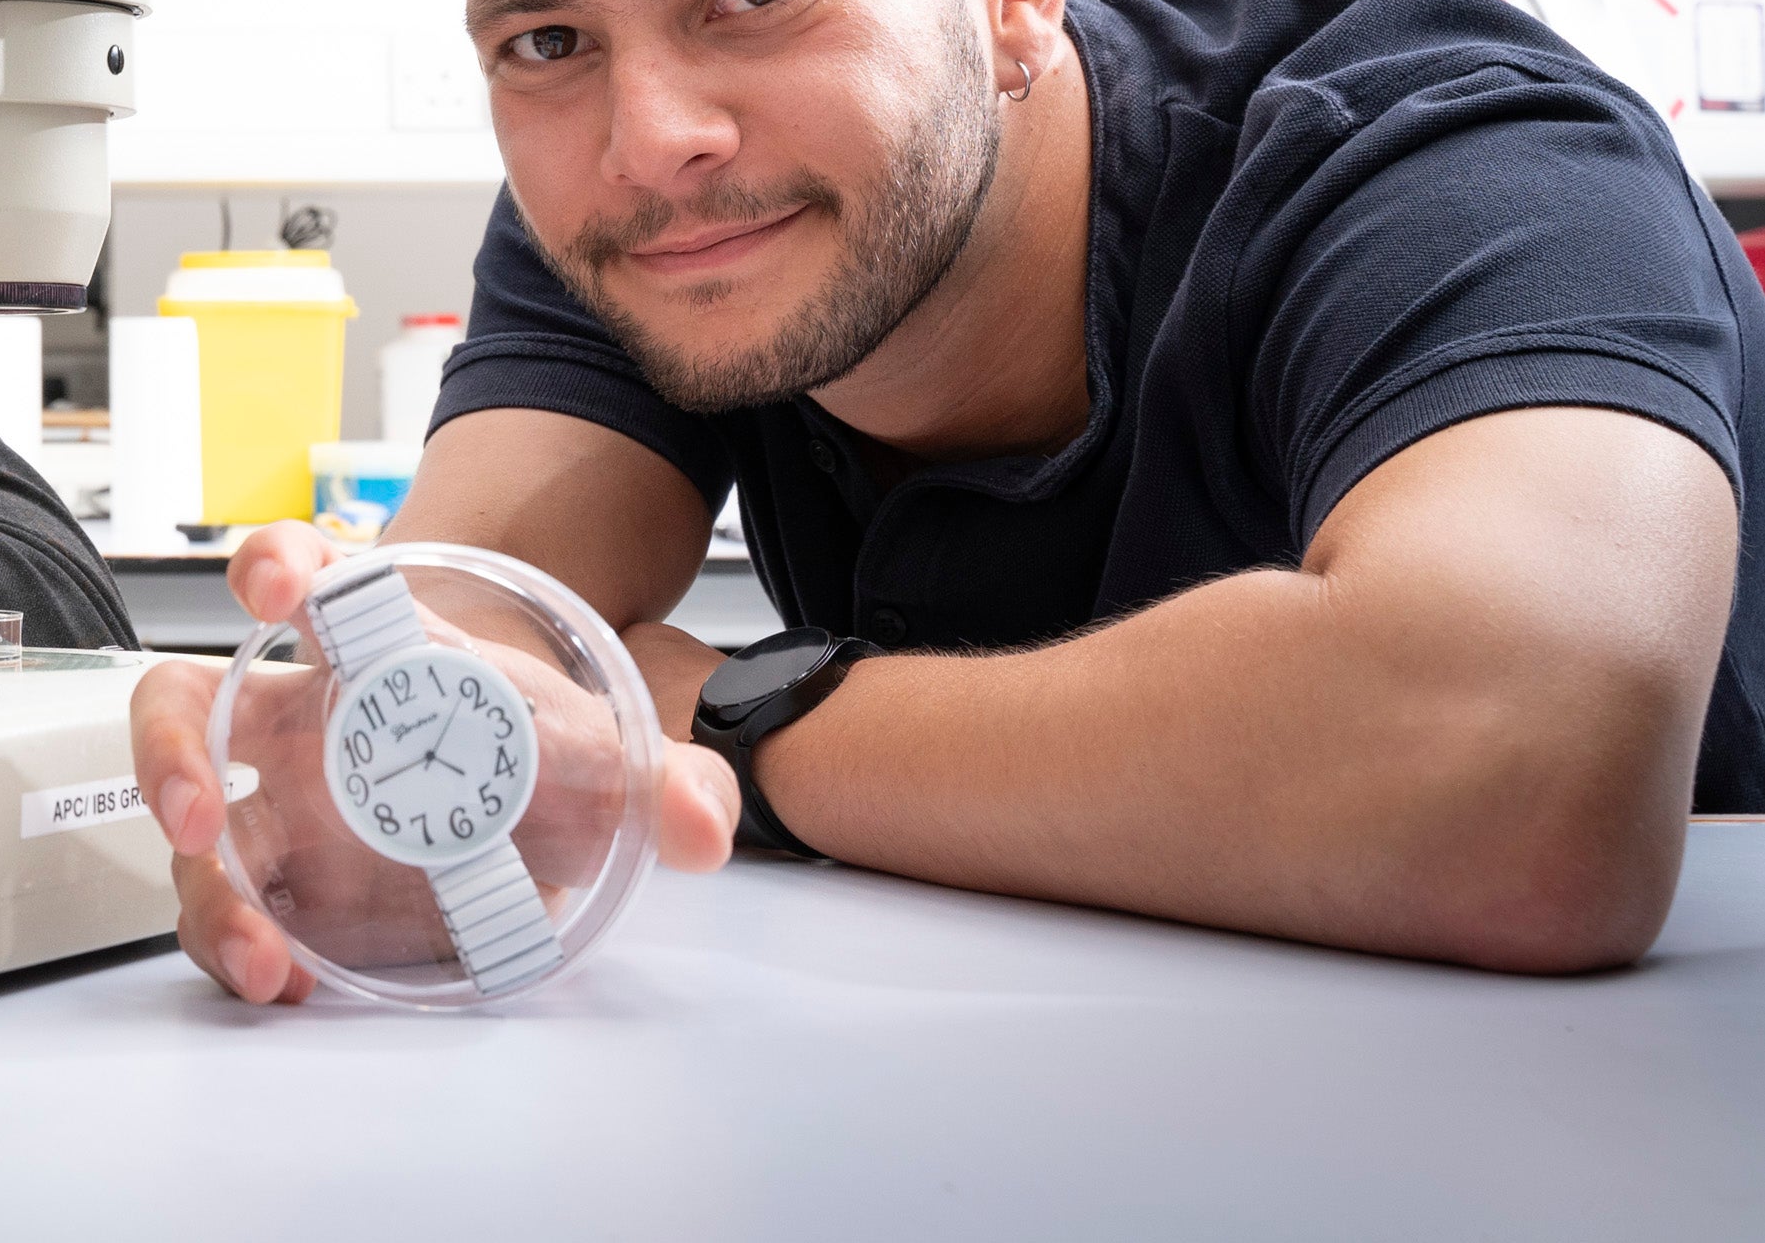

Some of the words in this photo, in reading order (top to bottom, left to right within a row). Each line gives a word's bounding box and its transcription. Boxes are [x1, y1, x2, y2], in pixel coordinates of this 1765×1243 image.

[382, 669, 418, 707] 12
[427, 663, 447, 698] 1
[459, 676, 489, 711] 2
[358, 694, 388, 731] 11
[486, 705, 514, 740] 3
[343, 729, 374, 769] 10
[492, 743, 520, 779] 4
[93, 792, 116, 815] IBS
[346, 773, 370, 809] 9
[477, 781, 503, 818] 5
[373, 802, 401, 836] 8
[409, 812, 436, 846] 7
[449, 806, 475, 840] 6
